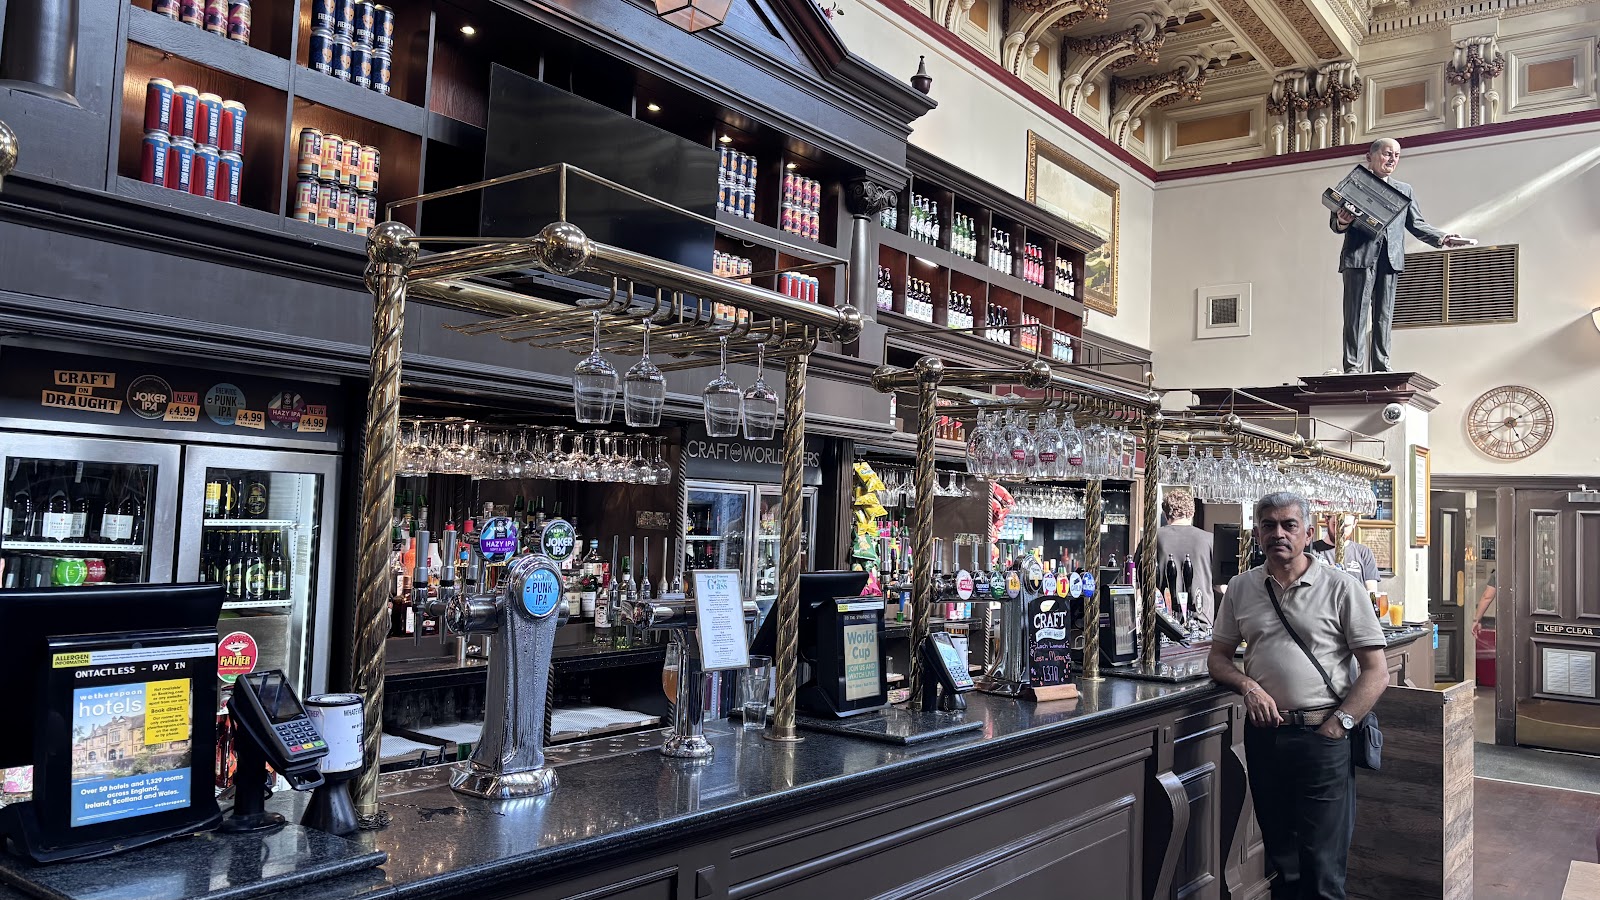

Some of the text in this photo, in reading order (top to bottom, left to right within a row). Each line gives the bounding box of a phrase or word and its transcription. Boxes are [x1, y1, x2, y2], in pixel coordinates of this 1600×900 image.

[59, 372, 110, 385] CRAFT
[45, 393, 117, 411] DRAUGHT
[133, 392, 167, 404] JOKER
[177, 393, 195, 403] NEW
[214, 395, 237, 406] PUNK
[141, 402, 157, 411] IPA
[169, 406, 196, 417] £4.99
[218, 407, 232, 417] IPA
[238, 412, 262, 422] £4.99
[302, 418, 324, 427] £4.99
[687, 440, 729, 460] CRAFT
[742, 446, 784, 465] WORLD
[546, 537, 573, 547] JOKER
[553, 546, 566, 555] IPA
[532, 582, 552, 593] PUNK
[536, 595, 547, 605] IPA
[1034, 611, 1067, 628] CRAFT
[1566, 626, 1593, 635] CLEAR
[847, 630, 874, 644] World
[852, 647, 870, 660] Cup
[75, 666, 135, 678] ONTACTLESS
[80, 690, 142, 700] wetherspoon
[79, 697, 142, 718] hotels
[146, 778, 162, 786] 1,329
[131, 785, 159, 795] England,
[85, 801, 111, 810] Ireland,
[113, 796, 142, 805] Scotland
